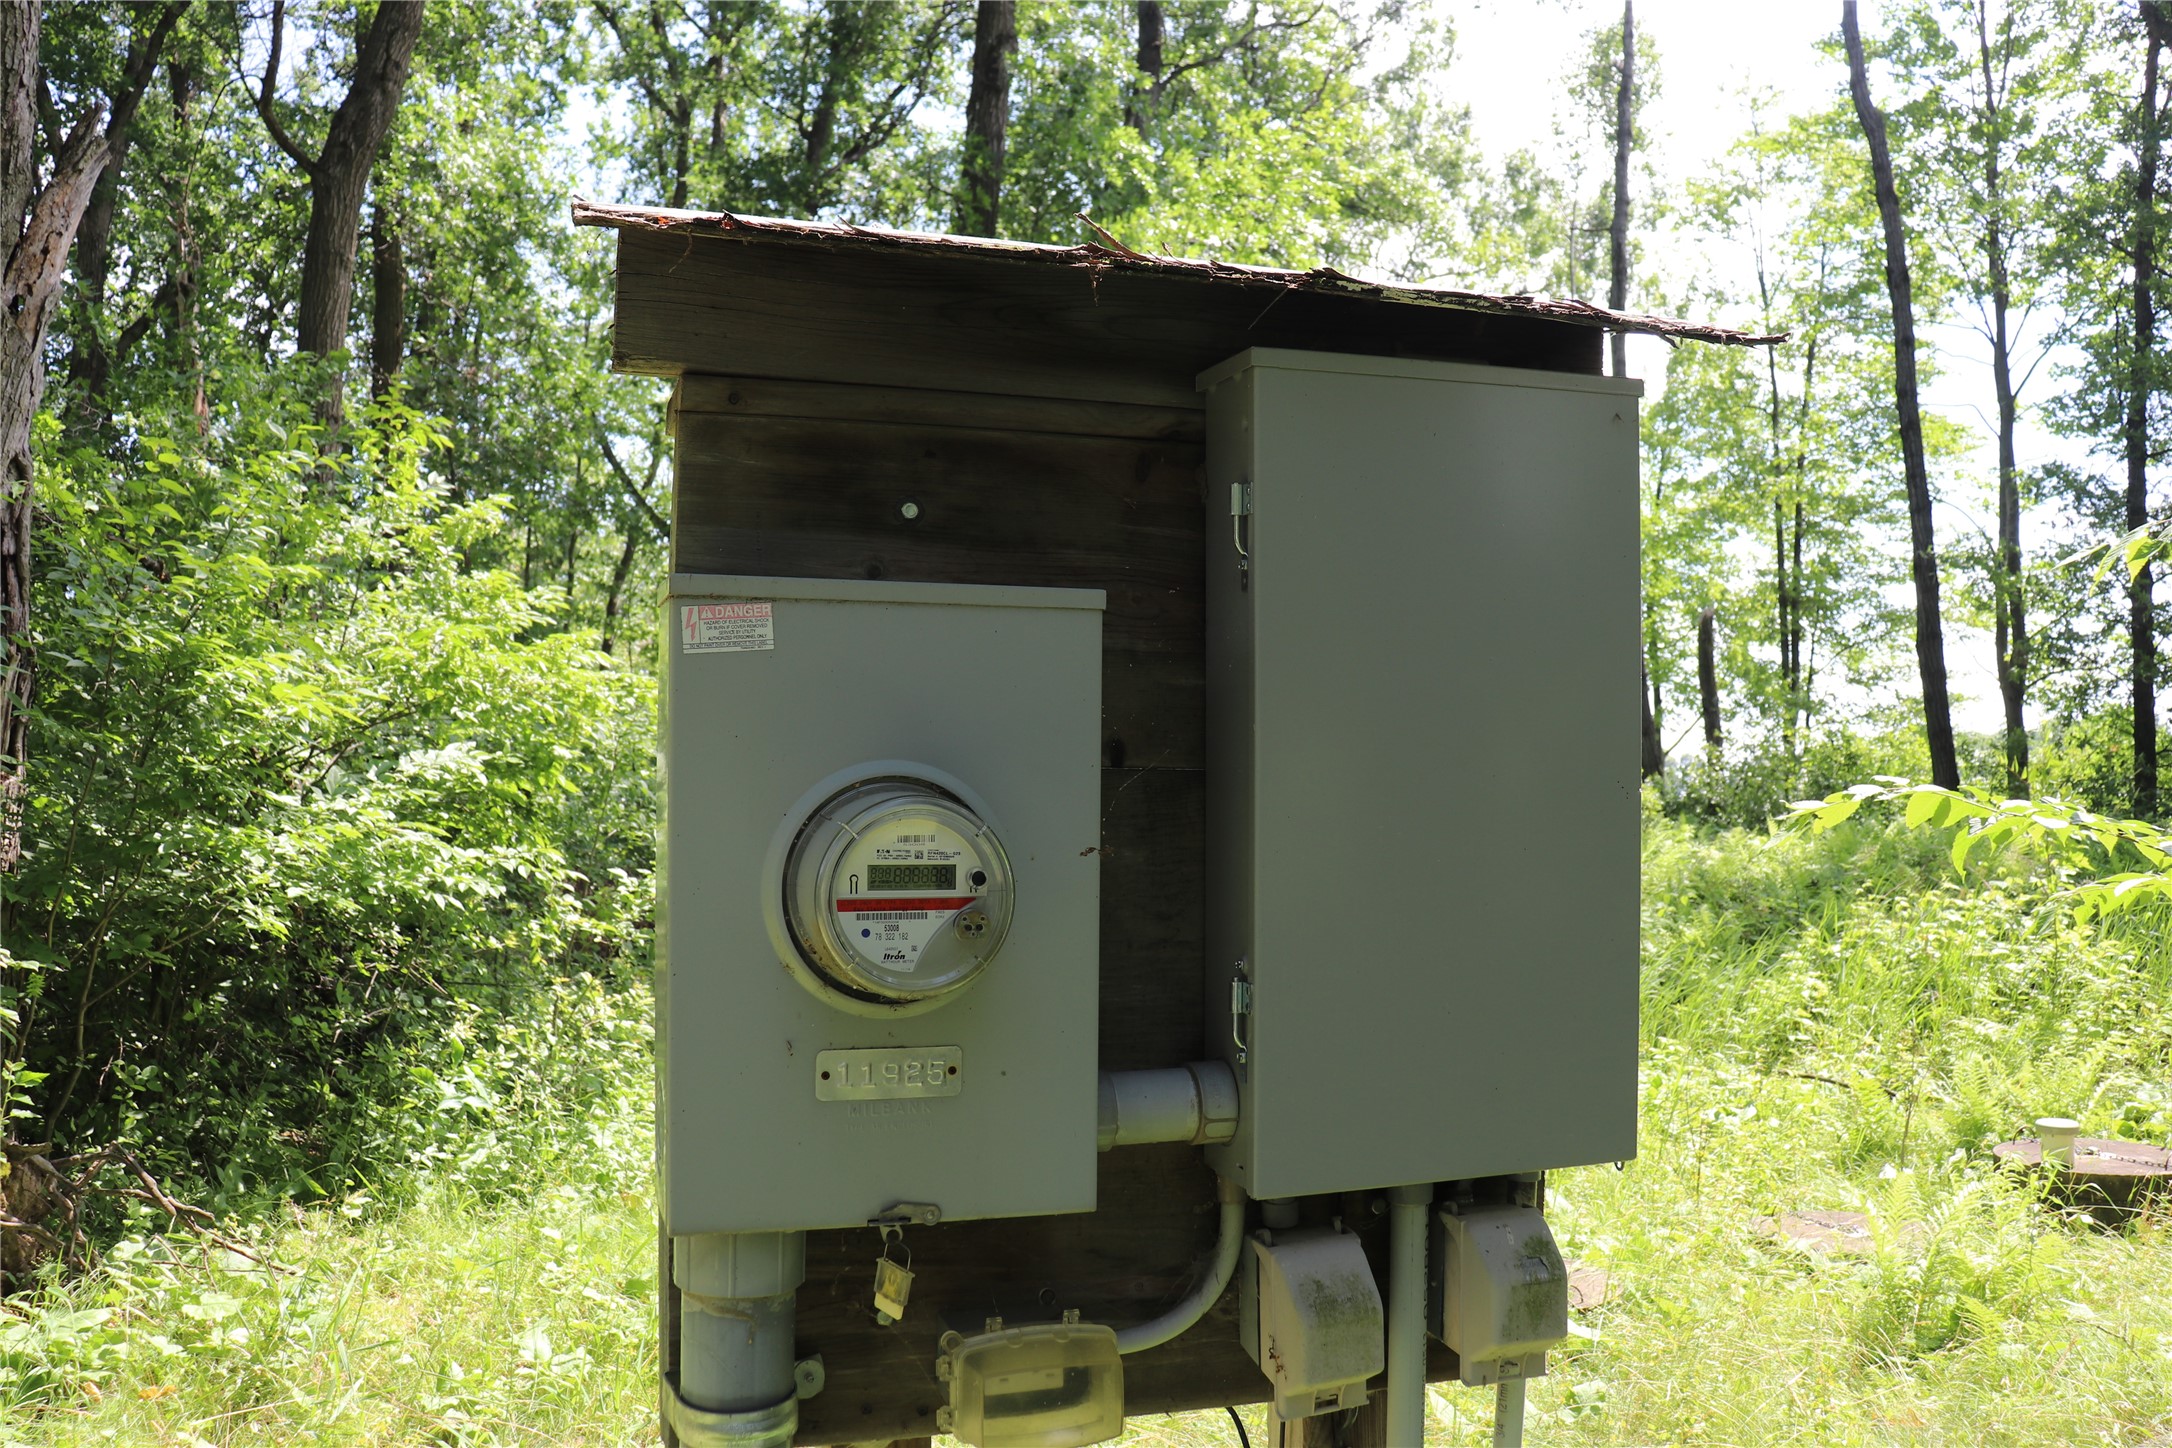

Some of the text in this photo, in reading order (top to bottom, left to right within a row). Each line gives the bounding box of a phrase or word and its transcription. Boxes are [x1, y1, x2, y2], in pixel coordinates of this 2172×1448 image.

[715, 604, 772, 618] DANGER
[837, 1058, 946, 1088] 11925
[848, 1102, 931, 1118] MILBANK
